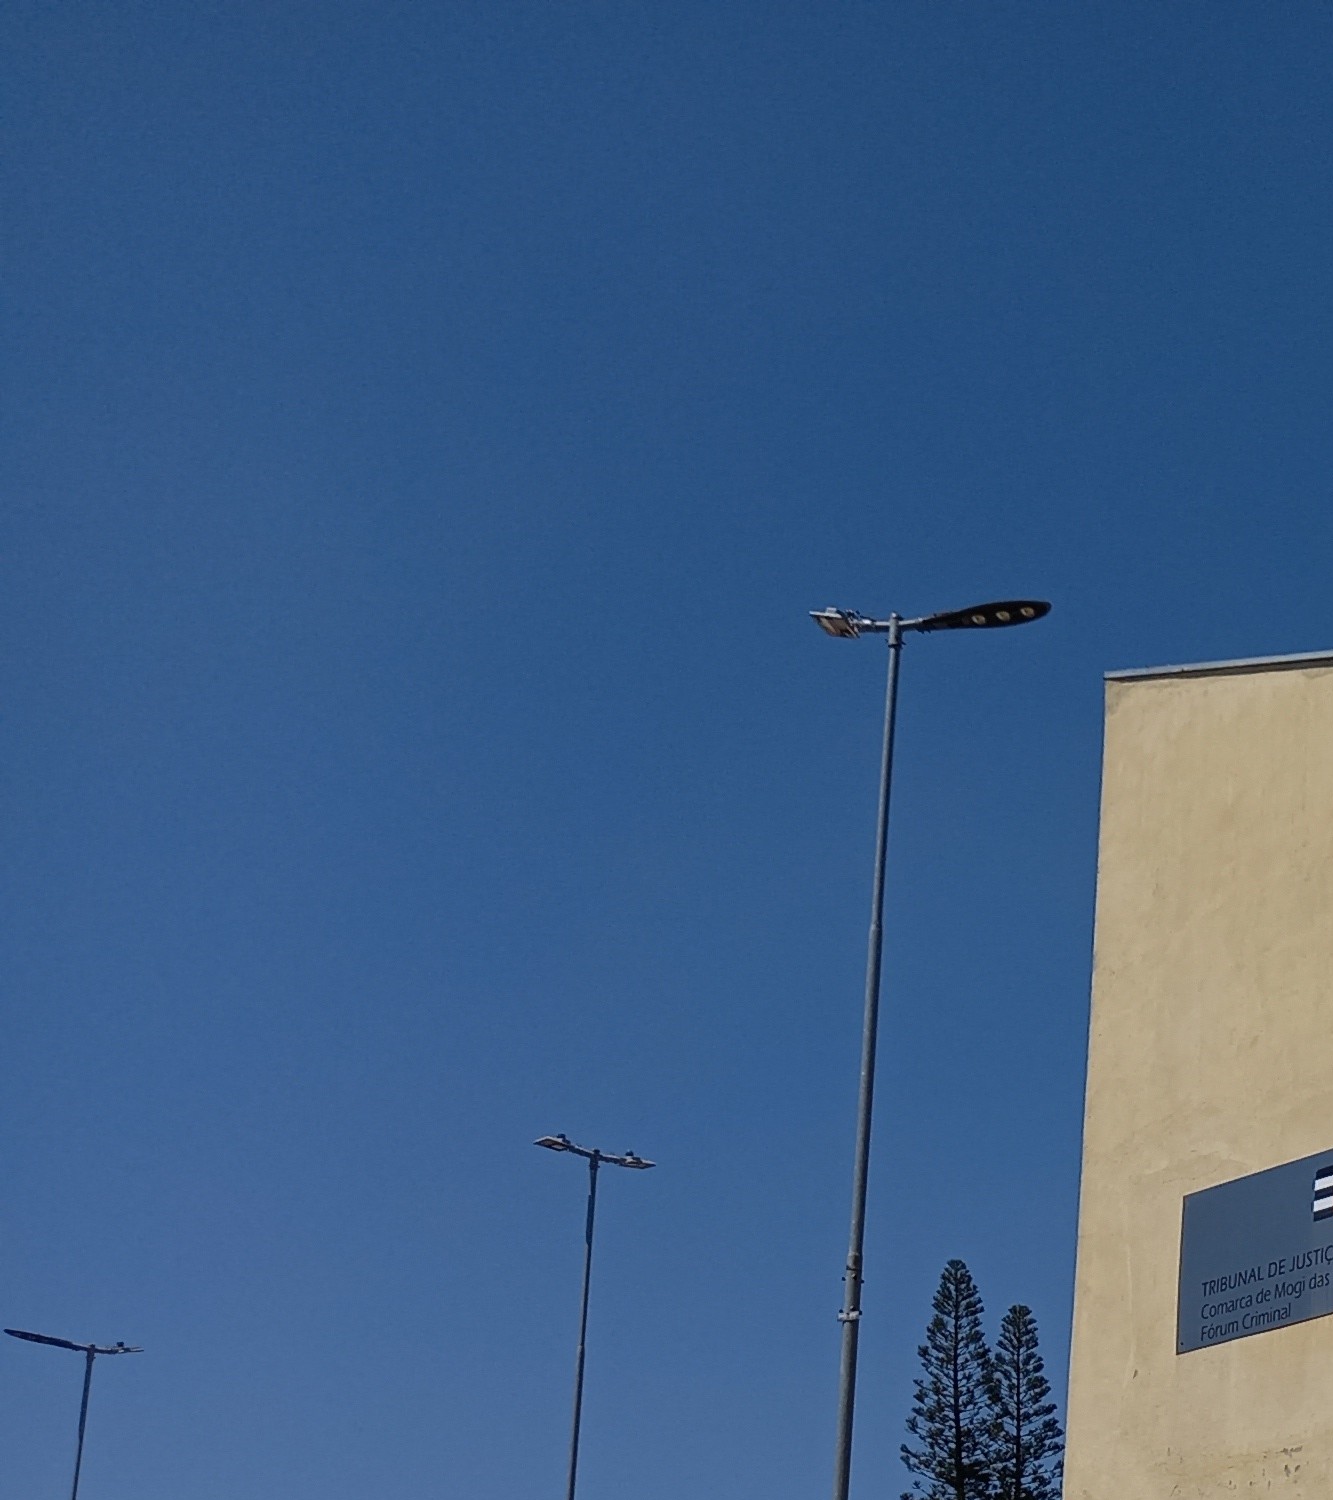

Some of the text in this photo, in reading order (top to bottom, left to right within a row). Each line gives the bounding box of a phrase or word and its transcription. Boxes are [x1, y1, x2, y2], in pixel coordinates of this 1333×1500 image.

[1201, 1294, 1253, 1320] Comarca
[1255, 1287, 1272, 1305] de
[1274, 1275, 1306, 1299] Mogi
[1309, 1273, 1330, 1290] das
[1202, 1266, 1265, 1297] TRIBUNAL
[1268, 1259, 1287, 1278] DE
[1200, 1302, 1292, 1341] Fórum Criminal
